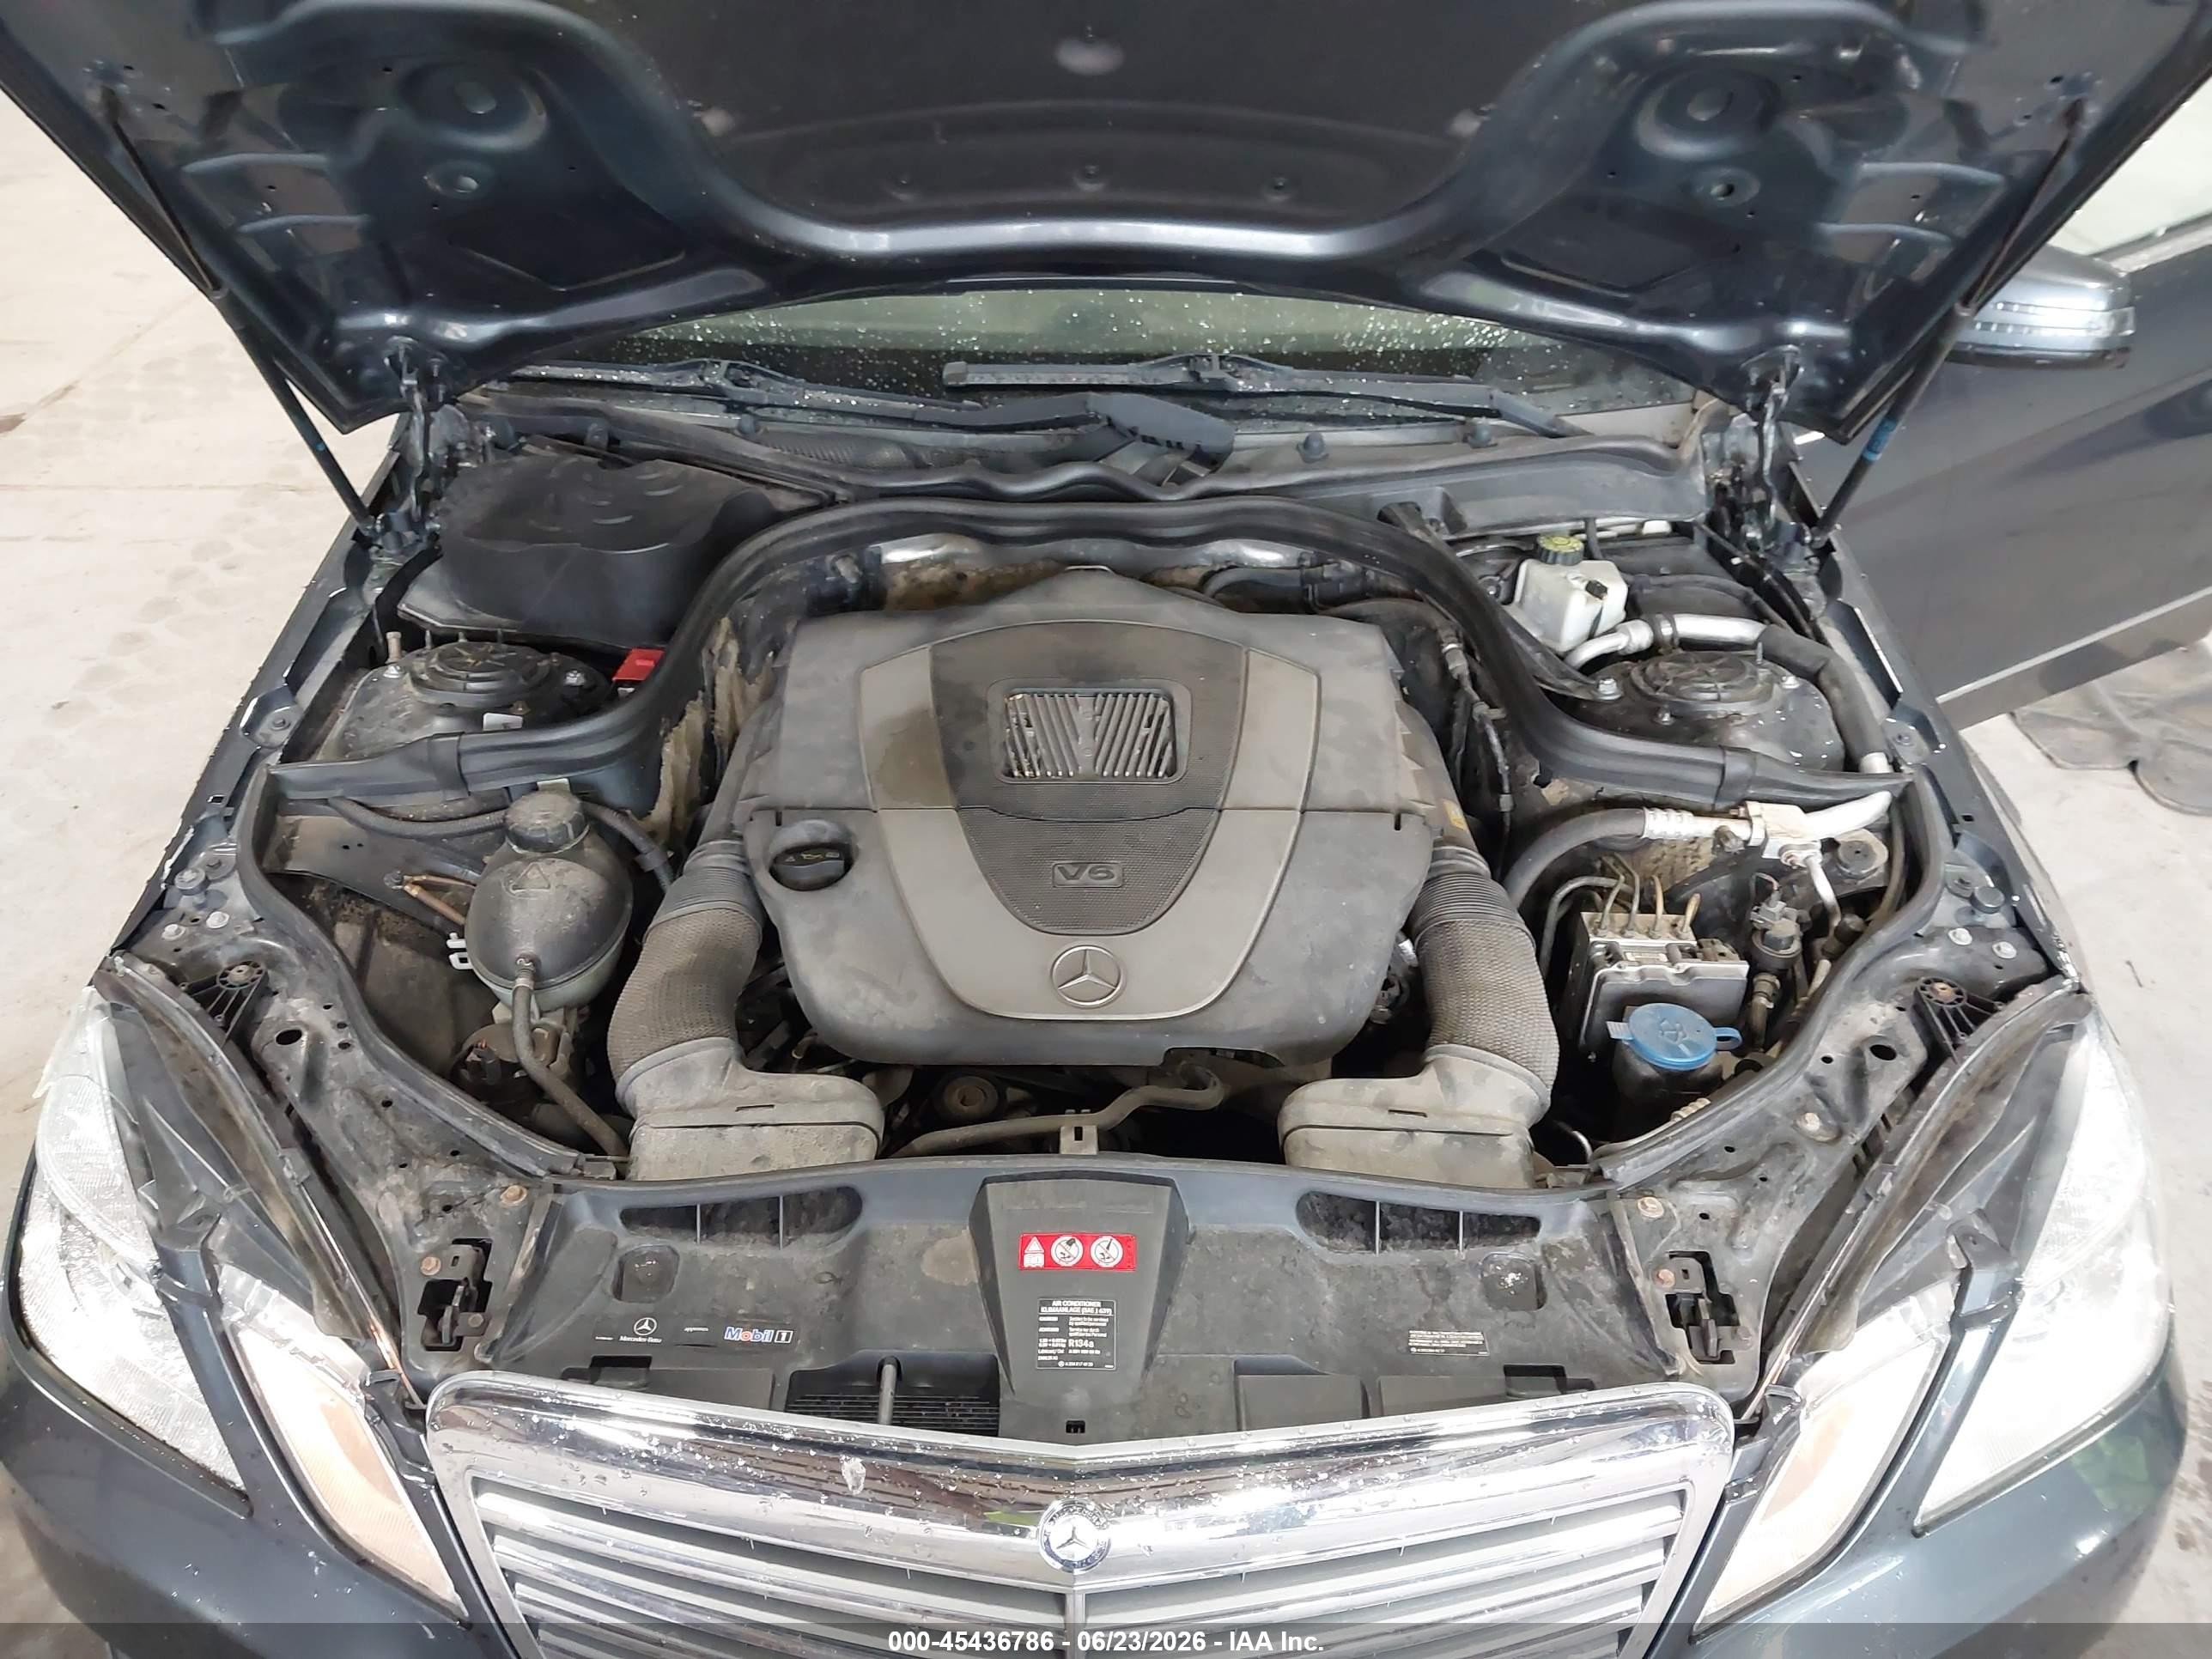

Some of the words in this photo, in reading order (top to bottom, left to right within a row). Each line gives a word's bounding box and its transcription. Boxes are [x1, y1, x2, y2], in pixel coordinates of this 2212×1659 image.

[1058, 865, 1115, 881] V6
[619, 1334, 662, 1343] Mercedes-Benz
[724, 1326, 774, 1343] Mobil
[1068, 1339, 1094, 1347] R134a
